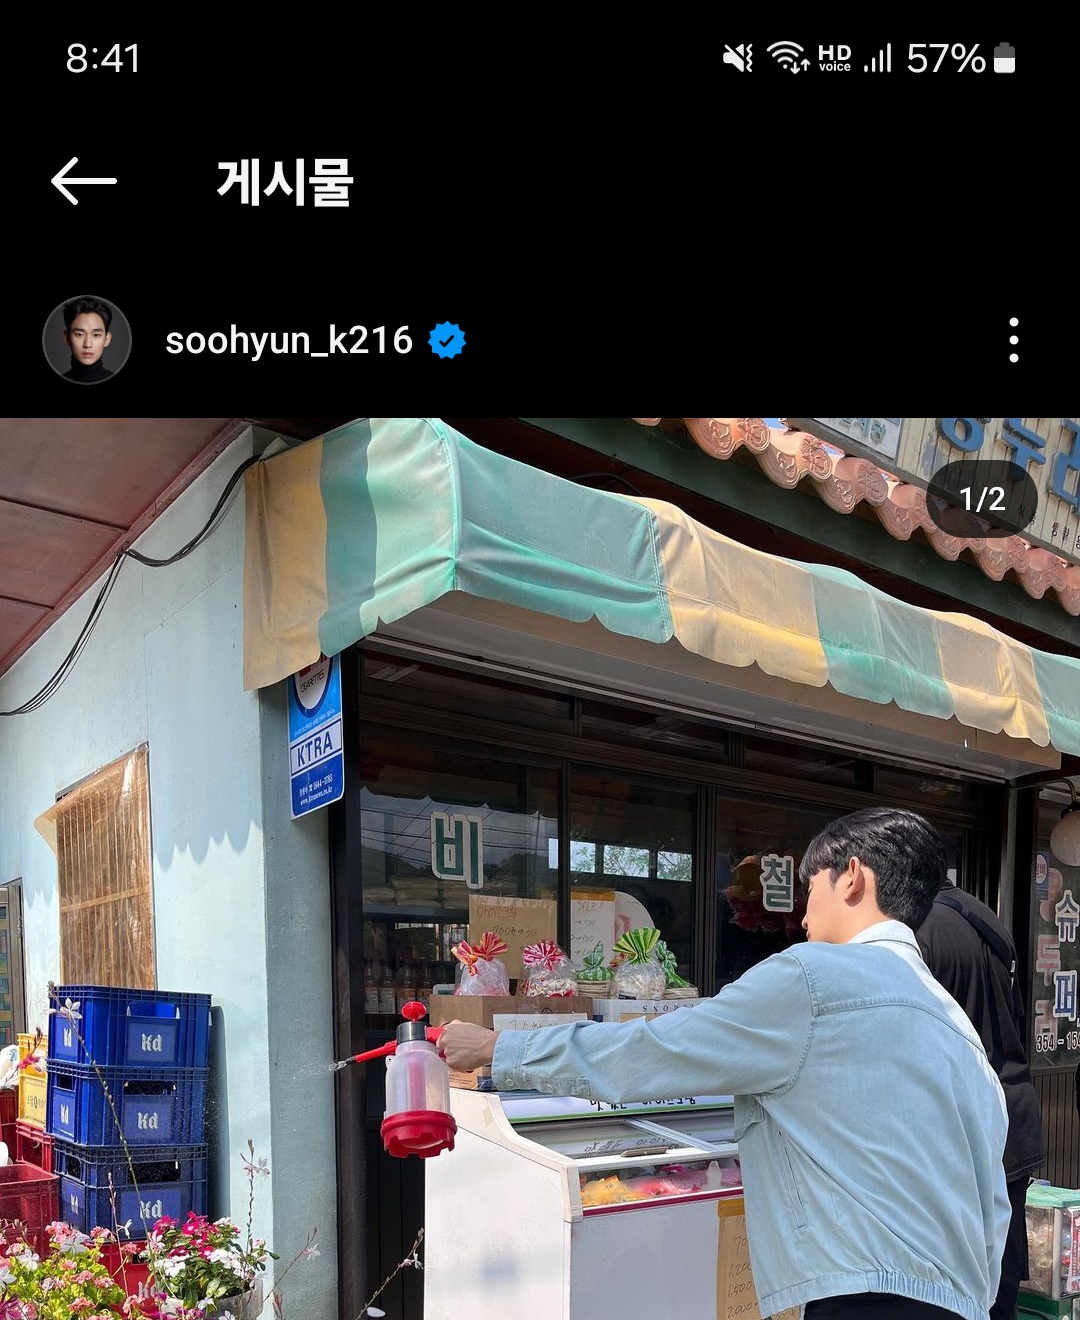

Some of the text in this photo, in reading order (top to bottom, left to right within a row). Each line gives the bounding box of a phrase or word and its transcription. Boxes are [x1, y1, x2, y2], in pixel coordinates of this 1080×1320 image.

[66, 42, 138, 74] 8:41
[818, 44, 852, 61] HD
[818, 61, 852, 72] voice
[907, 42, 987, 74] 57%
[216, 157, 354, 208] 게시물
[165, 323, 413, 362] soohyun_k216
[297, 731, 333, 768] KTRA
[431, 811, 484, 890] 비
[760, 853, 795, 913] 철
[141, 1033, 164, 1053] Kd
[137, 1111, 160, 1131] Kd
[139, 1198, 163, 1220] Kd
